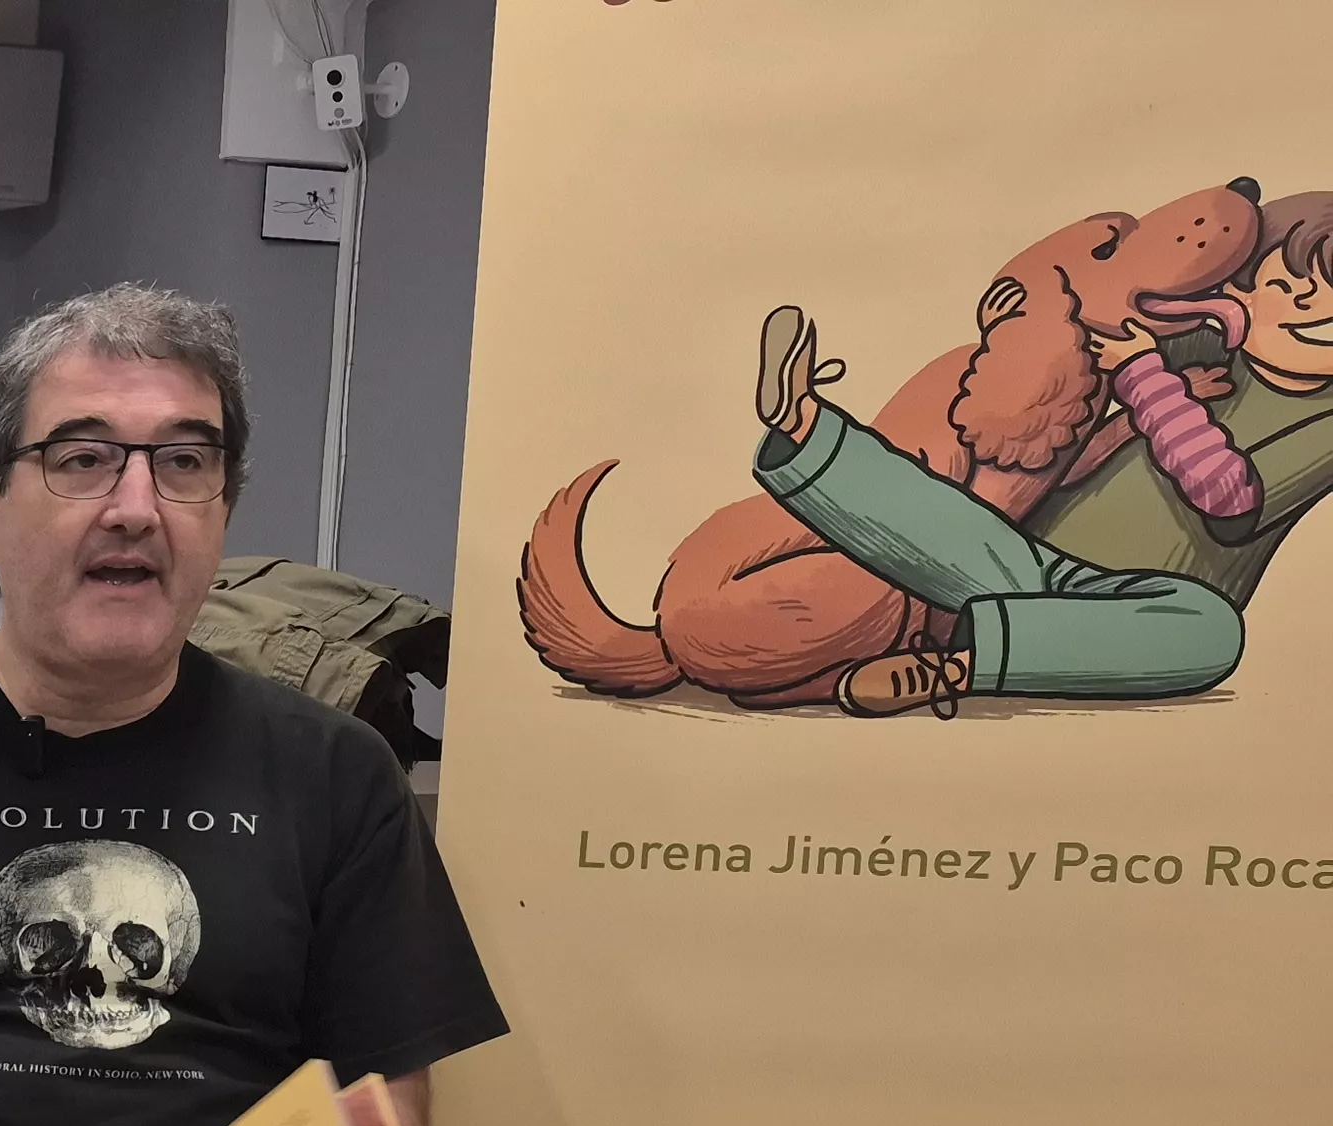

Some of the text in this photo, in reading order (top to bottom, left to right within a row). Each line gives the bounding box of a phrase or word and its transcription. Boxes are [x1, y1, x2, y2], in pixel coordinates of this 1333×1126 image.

[577, 831, 1333, 890] Lorena Jiménez y Paco Roca
[29, 1064, 85, 1076] HISTORY
[89, 1068, 101, 1078] IN
[145, 1070, 173, 1080] NEW
[175, 1070, 205, 1080] YORK
